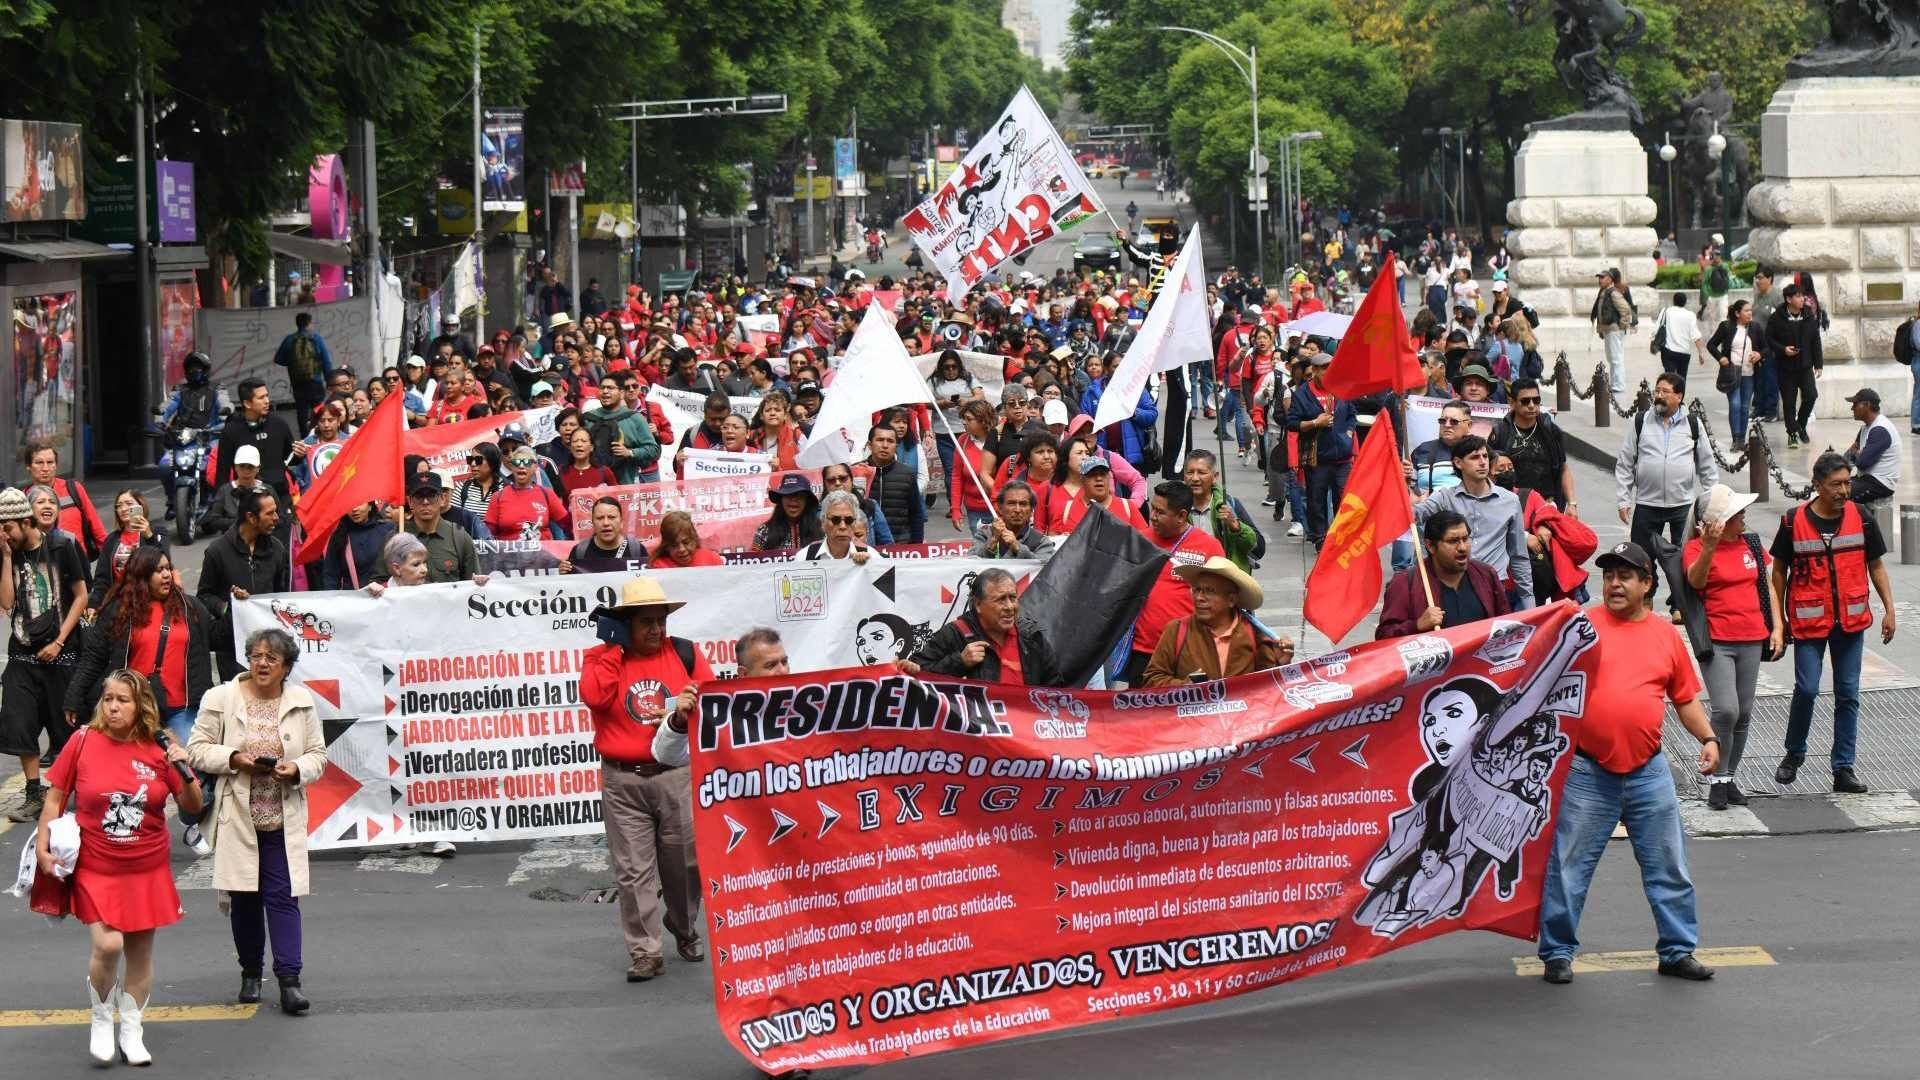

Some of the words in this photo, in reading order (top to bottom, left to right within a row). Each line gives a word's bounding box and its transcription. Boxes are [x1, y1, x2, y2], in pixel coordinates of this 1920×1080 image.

[695, 461, 747, 474] Sección
[749, 465, 761, 475] 9
[467, 589, 589, 620] Sección
[596, 585, 618, 609] 9
[552, 617, 597, 631] DEMOC
[783, 595, 824, 614] 2024
[399, 651, 519, 686] ¡ABROGACIÓN
[523, 651, 546, 675] DE
[550, 650, 571, 674] LA
[705, 640, 738, 665] 200
[401, 685, 514, 715] ¡Derogación
[517, 683, 541, 708] de
[544, 682, 562, 706] la
[699, 676, 1013, 752] PRESIDENTA:
[1208, 680, 1226, 704] 9
[403, 711, 524, 747] ¡ABROGACIÓN
[528, 712, 550, 736] DE
[553, 711, 575, 735] LA
[1034, 719, 1088, 739] CNTE
[404, 748, 508, 777] ¡Verdadera
[512, 741, 600, 770] profesion
[699, 768, 761, 808] ¿Con
[765, 762, 801, 795] los
[803, 745, 963, 789] trabajadores
[967, 756, 987, 777] o
[991, 757, 1046, 778] con
[1050, 754, 1092, 781] los
[407, 777, 500, 806] ¡GOBIERNE
[503, 773, 557, 800] QUIEN
[1108, 811, 1140, 829] acoso
[1190, 797, 1272, 819] autoritarismo
[1274, 797, 1282, 815] y
[1284, 791, 1318, 810] falsas
[1321, 787, 1398, 807] acusaciones.
[409, 806, 488, 835] ¡UNID@S
[490, 805, 502, 830] Y
[506, 799, 602, 828] ORGANIZAD
[723, 862, 793, 893] Homologación
[795, 859, 810, 879] de
[812, 852, 876, 882] prestaciones
[876, 851, 884, 869] y
[885, 844, 919, 862] bonos,
[921, 830, 974, 860] aguinaldo
[976, 828, 991, 847] de
[992, 825, 1008, 843] 90
[1010, 823, 1038, 841] días.
[1069, 841, 1119, 866] Vivienda
[1122, 838, 1159, 863] digna,
[1162, 836, 1199, 855] buena
[1202, 835, 1210, 854] y
[1212, 830, 1250, 849] barata
[1252, 828, 1279, 849] para
[1282, 823, 1299, 842] los
[1301, 817, 1382, 842] trabajadores.
[727, 900, 783, 928] Basificación
[783, 903, 790, 916] a
[789, 892, 841, 914] interinos,
[844, 878, 903, 904] continuidad
[905, 877, 918, 893] en
[920, 863, 1001, 890] contrataciones.
[1071, 874, 1134, 899] Devolución
[1137, 866, 1197, 889] inmediata
[1199, 862, 1214, 882] de
[1216, 858, 1283, 879] descuentos
[1285, 851, 1352, 873] arbitrarios.
[731, 943, 763, 963] Bonos
[764, 938, 785, 960] para
[784, 923, 826, 956] jubilados
[827, 921, 857, 940] como
[859, 921, 872, 934] se
[875, 911, 915, 934] otorgan
[917, 909, 930, 925] en
[932, 903, 958, 922] otras
[960, 891, 1017, 915] entidades.
[1072, 912, 1112, 934] Mejora
[1114, 904, 1159, 926] integral
[1161, 897, 1180, 919] del
[1182, 895, 1227, 915] sistema
[1229, 886, 1280, 909] sanitario
[1282, 884, 1302, 904] del
[735, 977, 766, 998] Becas
[767, 971, 786, 995] para
[785, 962, 808, 988] hij@s
[808, 962, 821, 979] de
[822, 950, 886, 977] trabajadores
[888, 943, 902, 963] de
[904, 940, 914, 959] la
[916, 932, 974, 958] educación.
[740, 1001, 837, 1057] ¡UNID@S
[843, 994, 864, 1028] Y
[871, 953, 1103, 1021] ORGANIZAD@S,
[854, 1041, 867, 1056] de
[868, 1026, 950, 1058] Trabajadores
[953, 1020, 969, 1037] de
[971, 1016, 983, 1034] la
[986, 1006, 1051, 1031] Educación
[1087, 990, 1151, 1013] Secciones
[1153, 984, 1168, 1002] 9,
[1169, 981, 1192, 999] 10,
[1195, 978, 1211, 995] 11
[1213, 980, 1223, 996] y
[1226, 973, 1243, 989] 60
[1245, 964, 1289, 985] Ciudad
